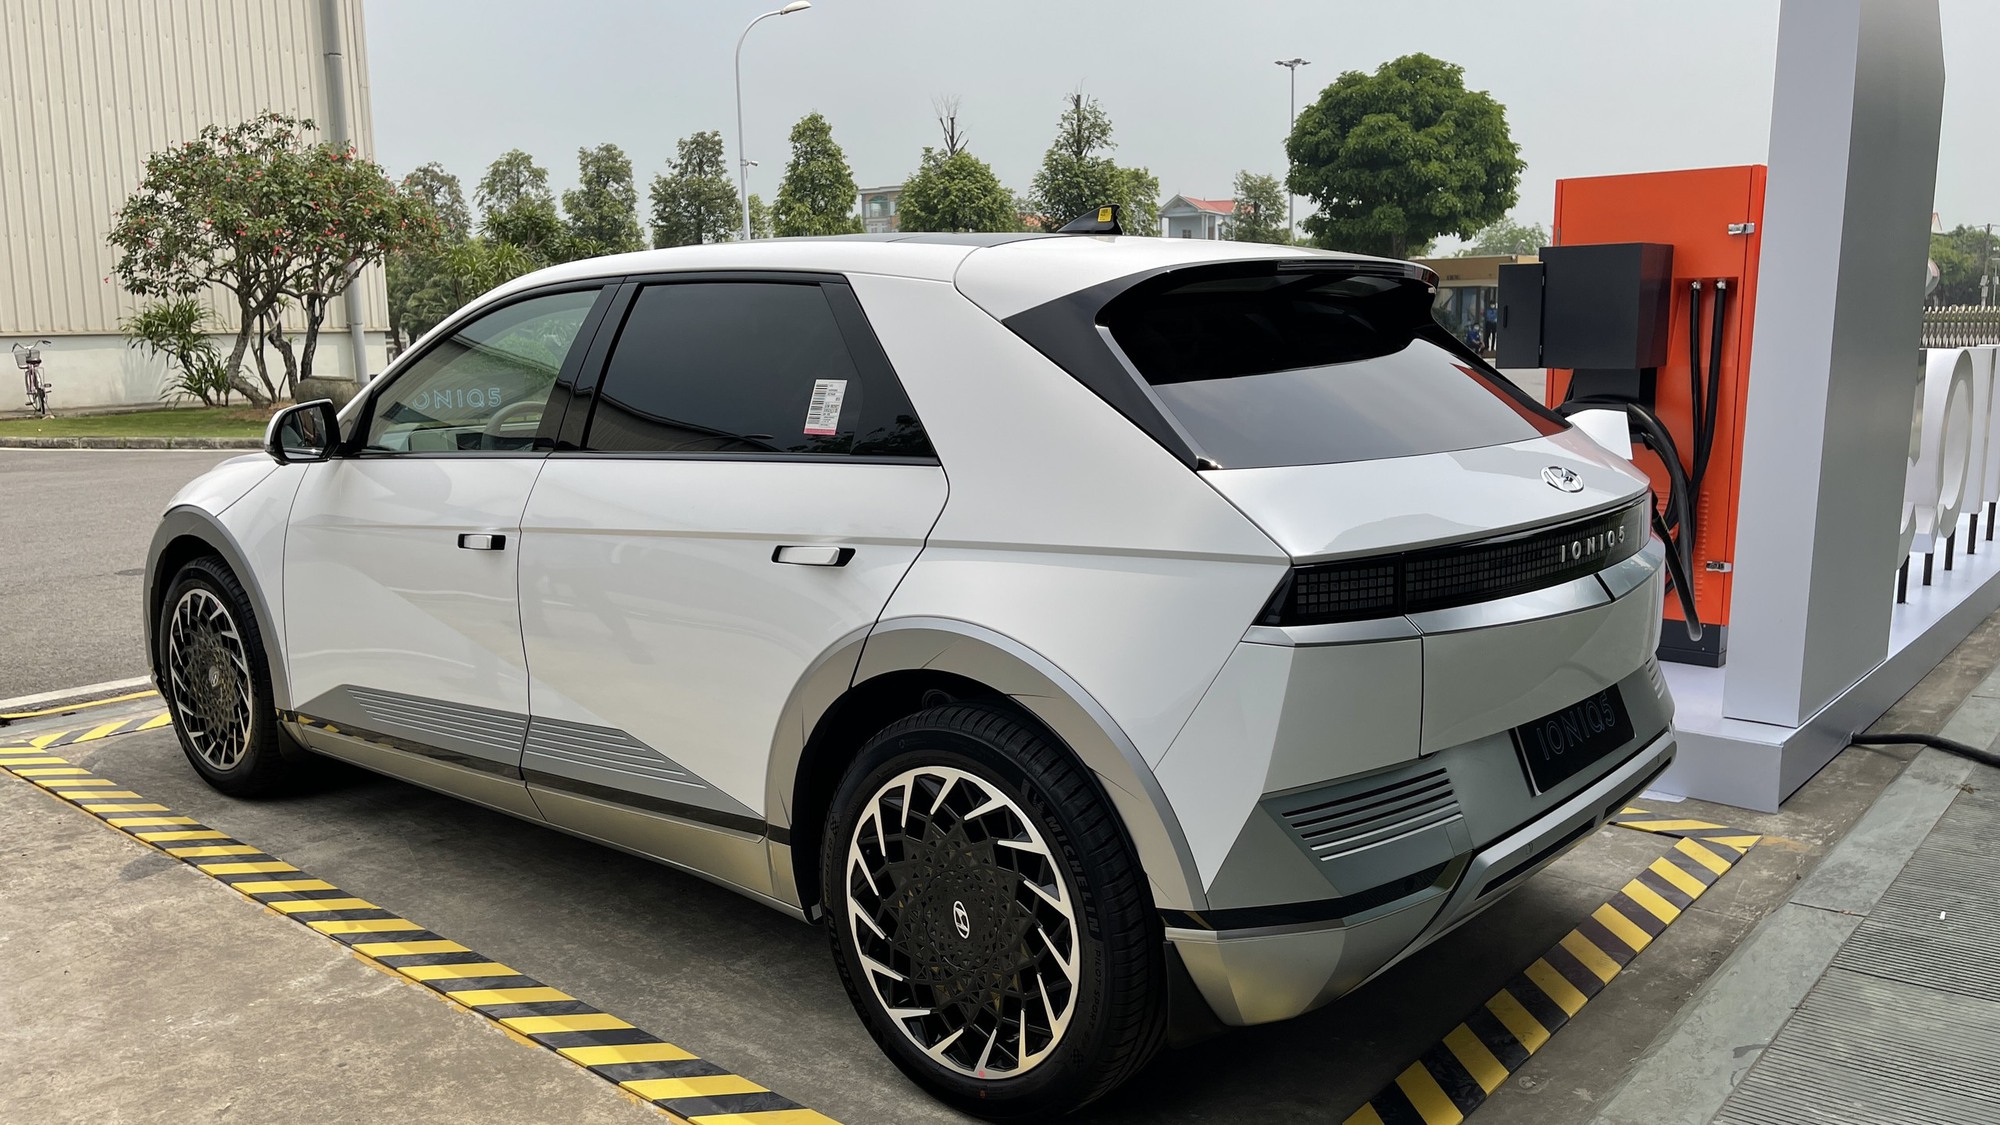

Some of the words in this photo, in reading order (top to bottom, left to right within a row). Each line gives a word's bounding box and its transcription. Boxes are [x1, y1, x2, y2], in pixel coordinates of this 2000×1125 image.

[404, 387, 502, 410] ONIQ5
[1536, 690, 1616, 761] IONIQ5
[1044, 815, 1101, 934] MICHELIN
[1093, 949, 1102, 986] PILOT
[1085, 988, 1101, 1031] SPORT
